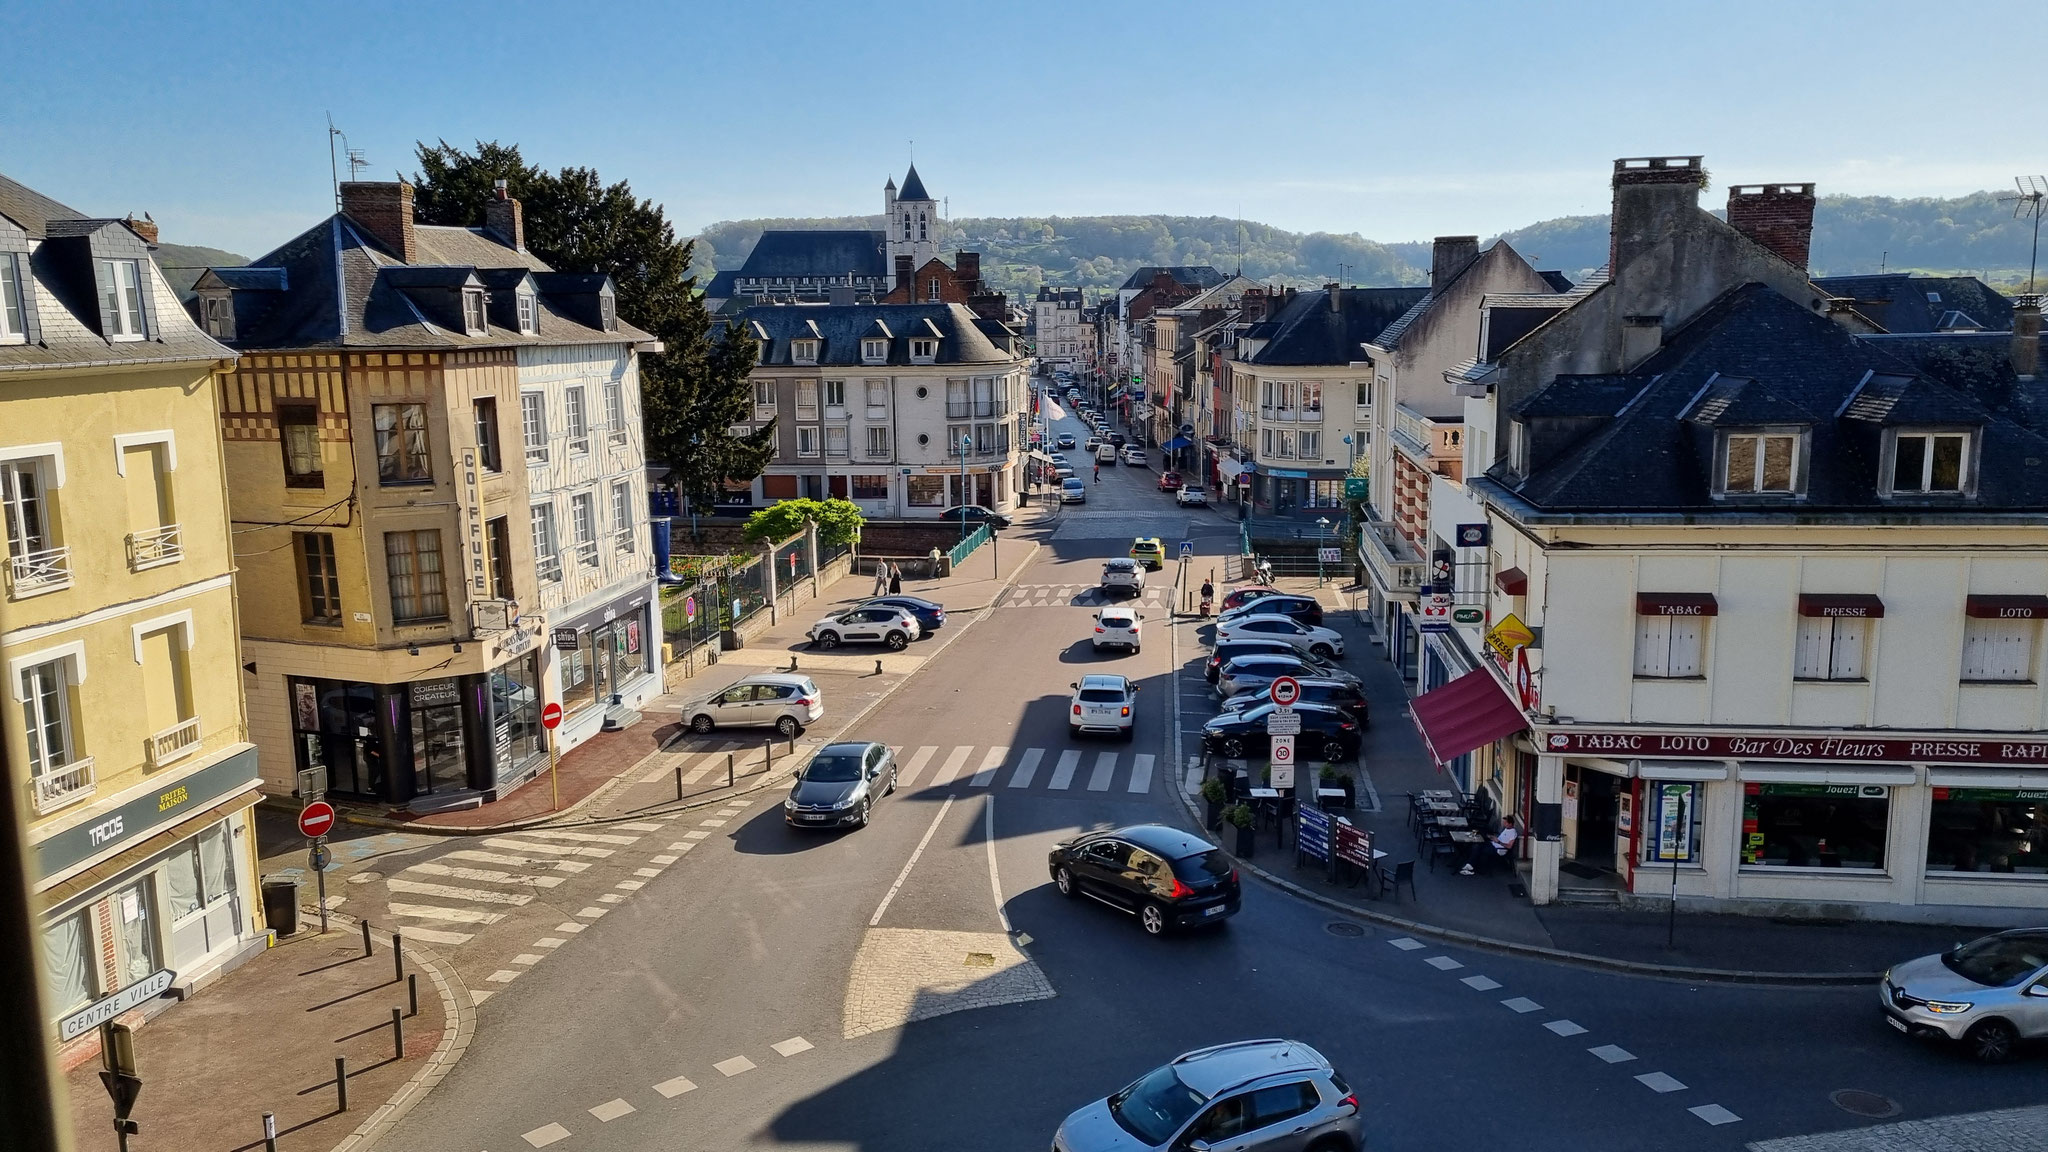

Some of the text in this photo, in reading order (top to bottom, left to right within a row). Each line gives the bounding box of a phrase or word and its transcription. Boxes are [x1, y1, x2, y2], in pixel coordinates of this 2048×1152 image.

[464, 454, 485, 589] COIFFURE
[1658, 605, 1702, 614] TABAC
[1824, 607, 1866, 616] PRESSE
[2000, 608, 2032, 618] LOTO
[558, 630, 576, 641] shiva
[414, 683, 455, 694] COIFFEUR
[414, 691, 456, 702] CREATEUR
[1575, 734, 1642, 749] TABAC
[1660, 736, 1710, 750] LOTO
[1728, 737, 1771, 754] Bar
[1773, 738, 1814, 756] Des
[1820, 737, 1886, 758] Fleurs
[1910, 742, 1982, 756] PRESSE
[2002, 744, 2048, 758] RAPI
[160, 786, 186, 802] FRITES
[1826, 786, 1858, 794] Jouez!
[158, 793, 188, 813] MAISON
[88, 816, 124, 847] TACOS
[68, 974, 164, 1034] CENTRE VILLE
